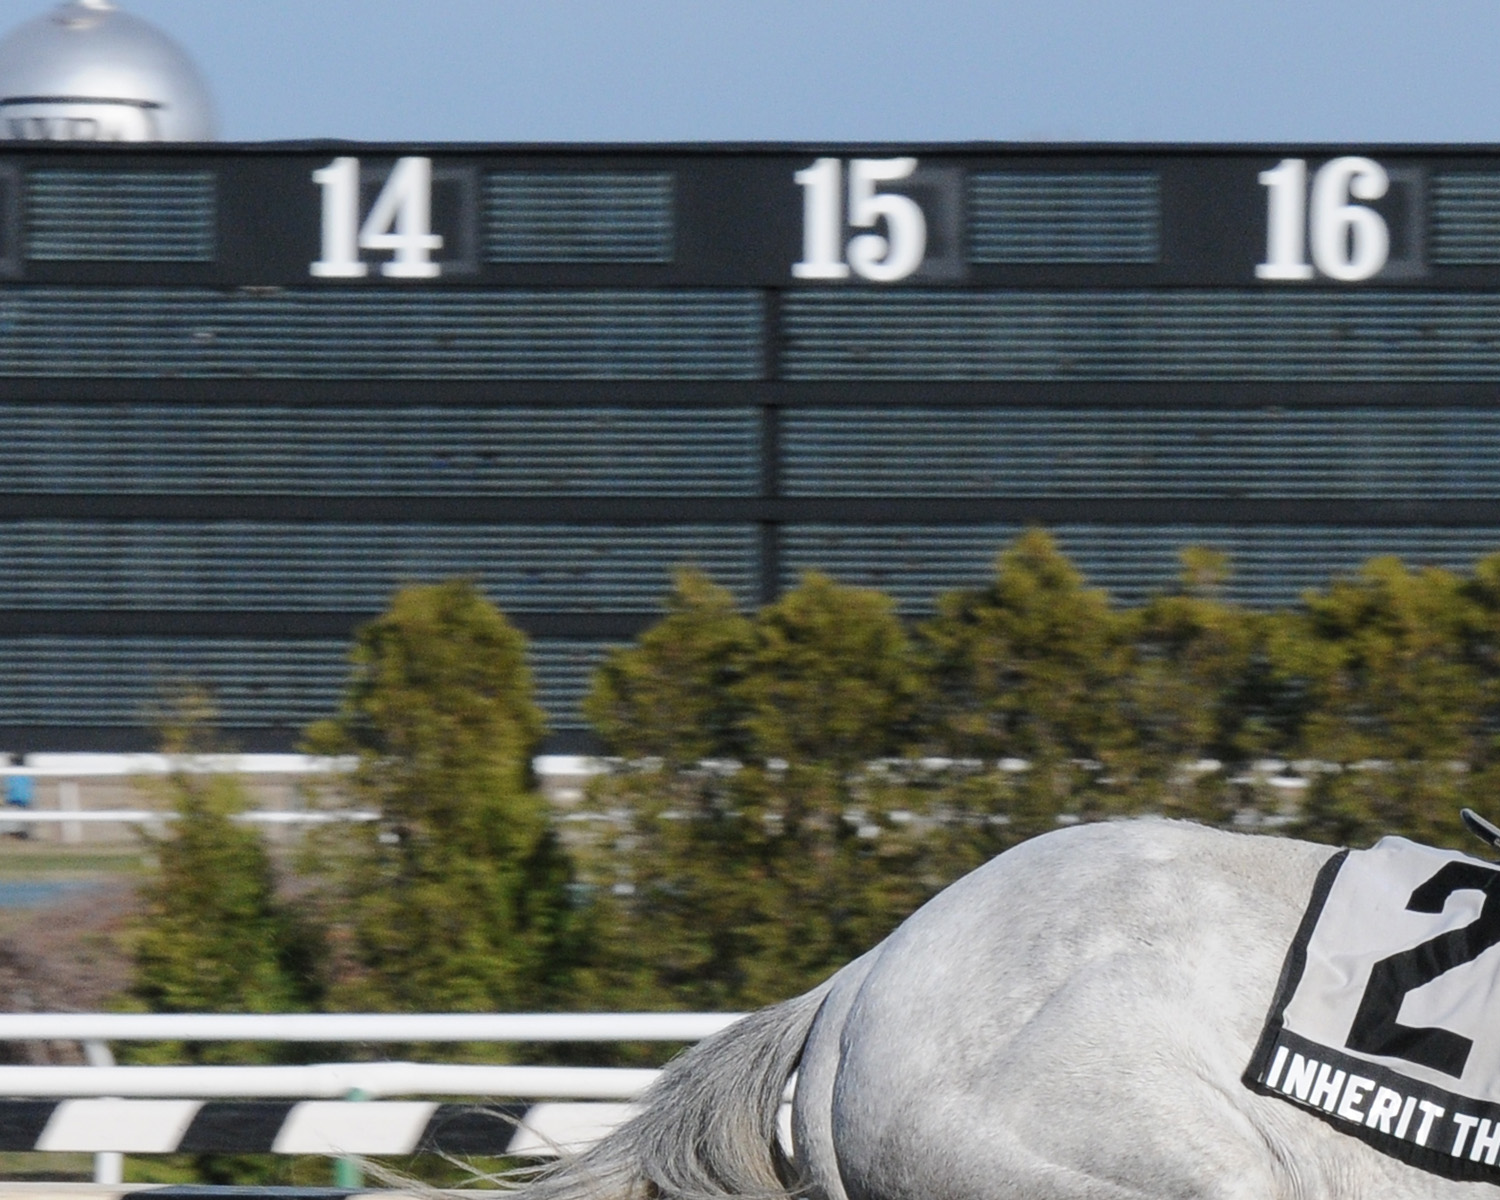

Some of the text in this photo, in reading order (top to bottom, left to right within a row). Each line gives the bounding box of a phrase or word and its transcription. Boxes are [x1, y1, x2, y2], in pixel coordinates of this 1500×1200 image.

[310, 156, 443, 278] 14
[792, 157, 927, 282] 15
[1256, 156, 1390, 281] 16
[1265, 1045, 1445, 1146] INHERIT
